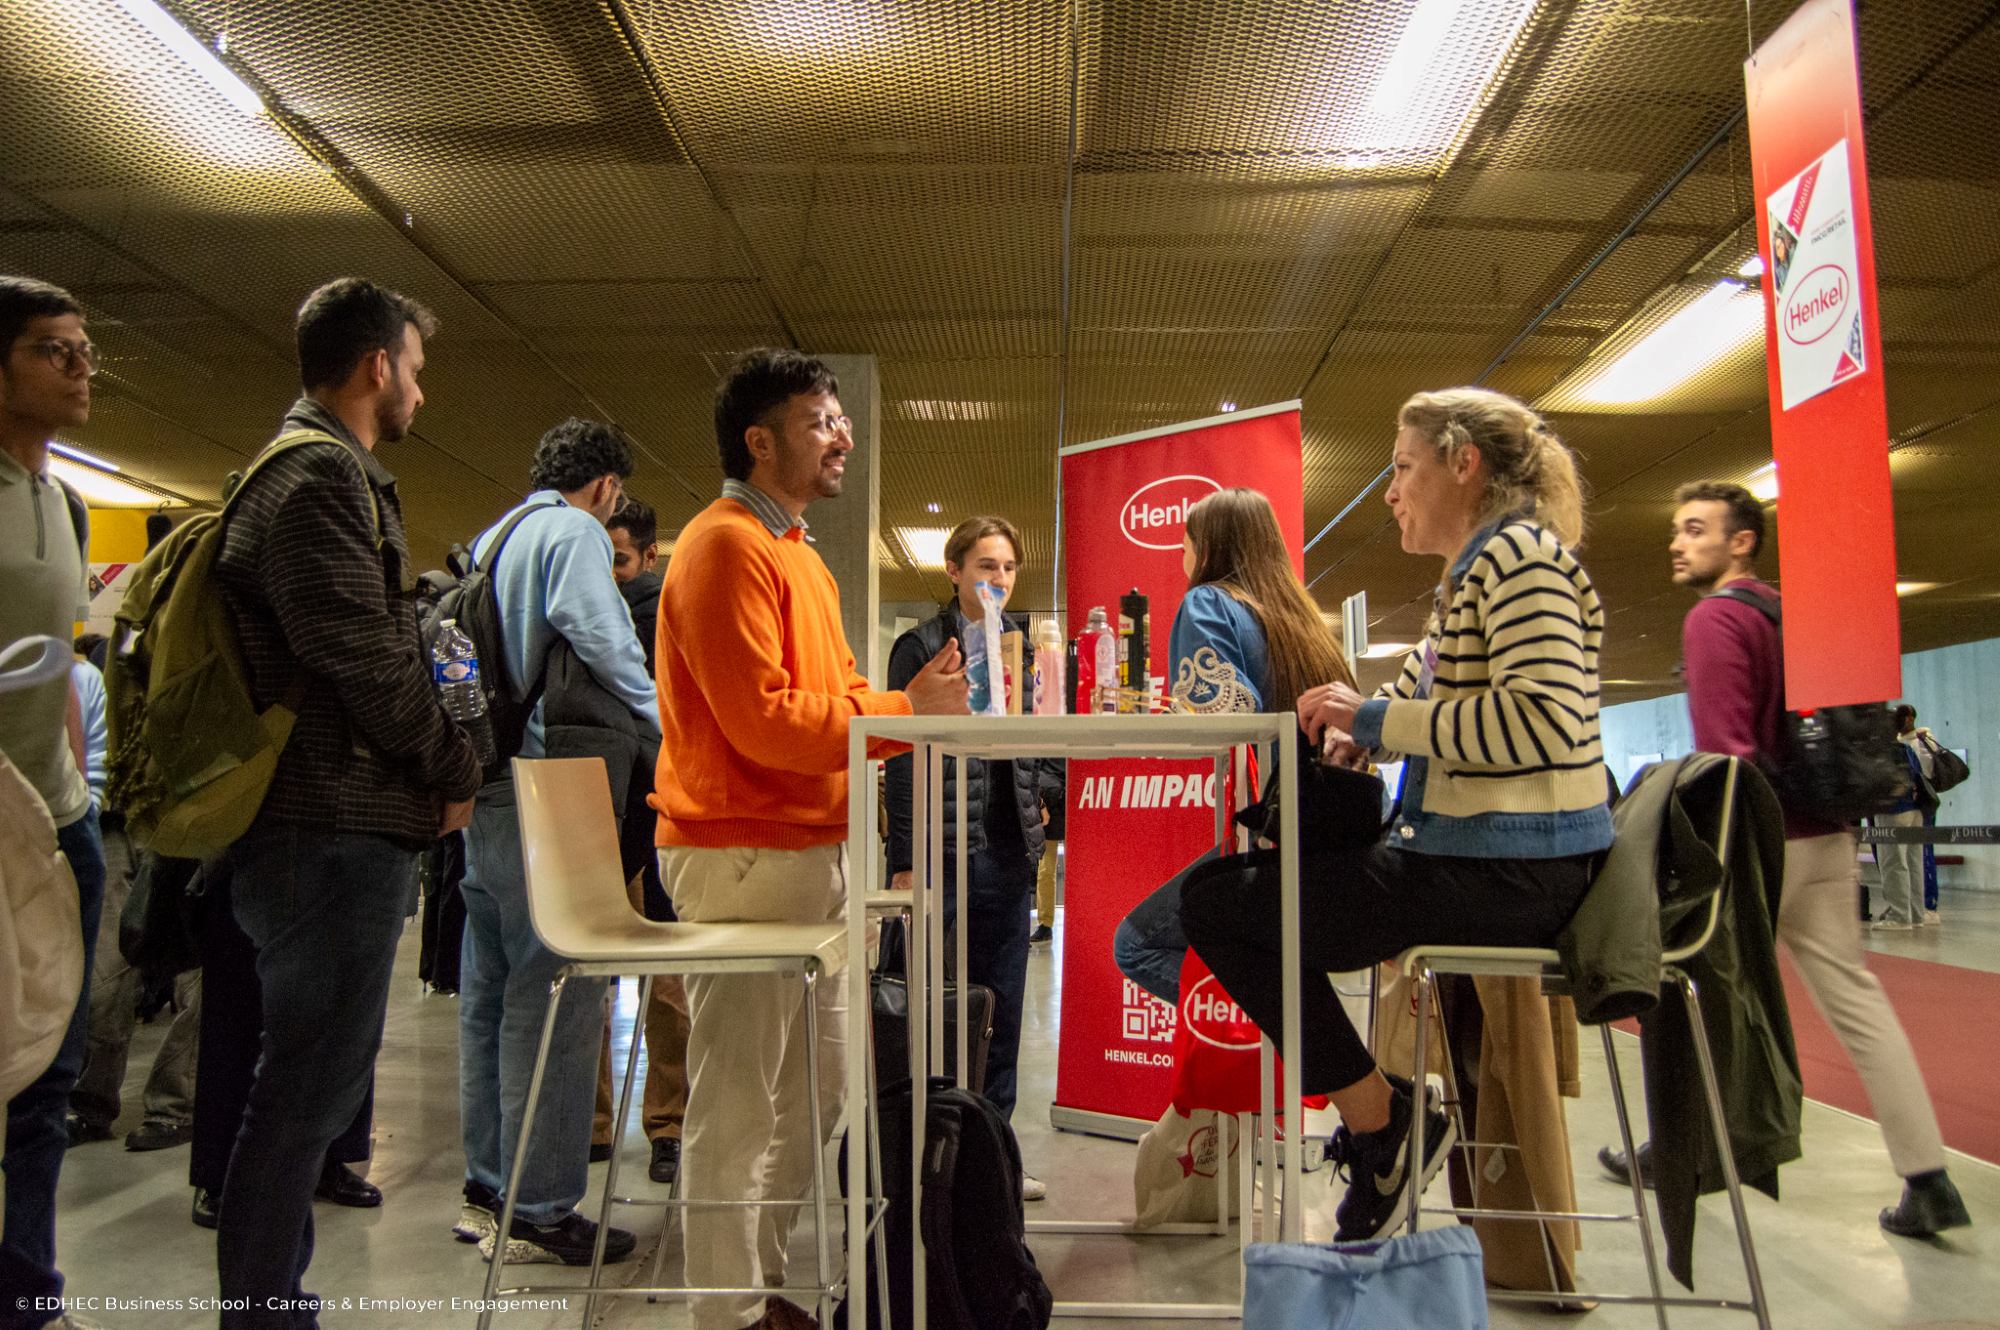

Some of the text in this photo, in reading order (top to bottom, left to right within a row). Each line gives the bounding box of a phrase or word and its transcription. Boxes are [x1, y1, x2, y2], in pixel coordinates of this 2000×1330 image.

[1790, 277, 1843, 331] Henkel
[1130, 498, 1198, 530] Henk
[1079, 773, 1230, 808] AN IMPAC
[1865, 828, 1897, 838] EDHEC
[1954, 827, 1993, 838] EDHEC
[1104, 1049, 1174, 1068] HENKEL.CO
